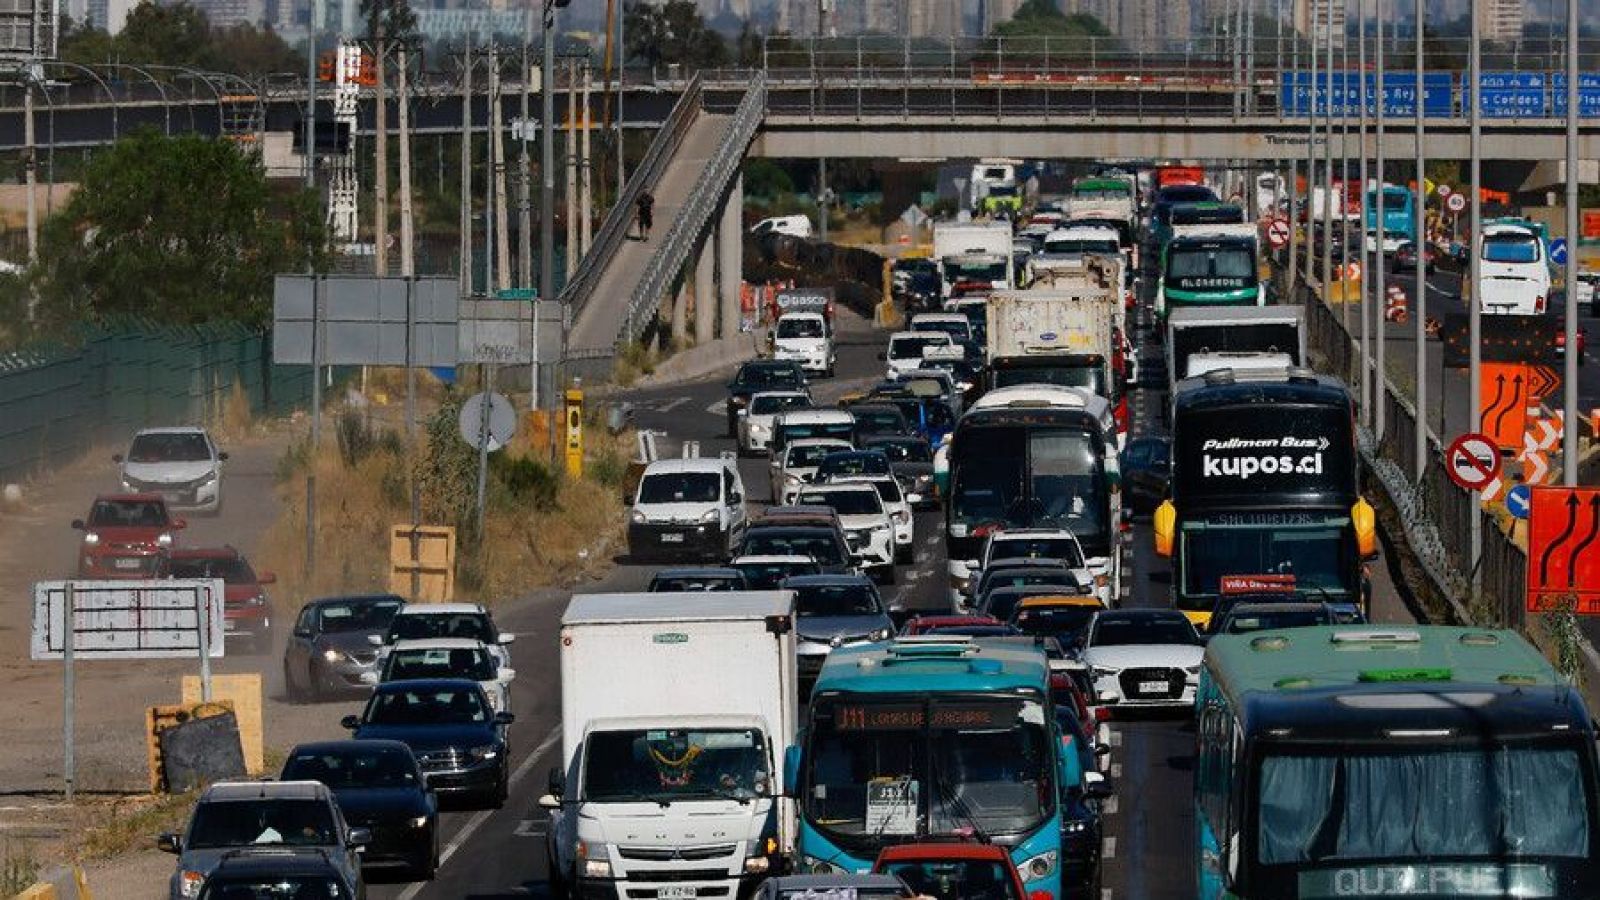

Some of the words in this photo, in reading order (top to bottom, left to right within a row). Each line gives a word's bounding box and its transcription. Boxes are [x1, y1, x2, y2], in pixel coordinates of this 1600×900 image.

[1203, 438, 1279, 450] Pullman
[1280, 436, 1317, 447] Bus
[1203, 452, 1323, 479] kupos.cl
